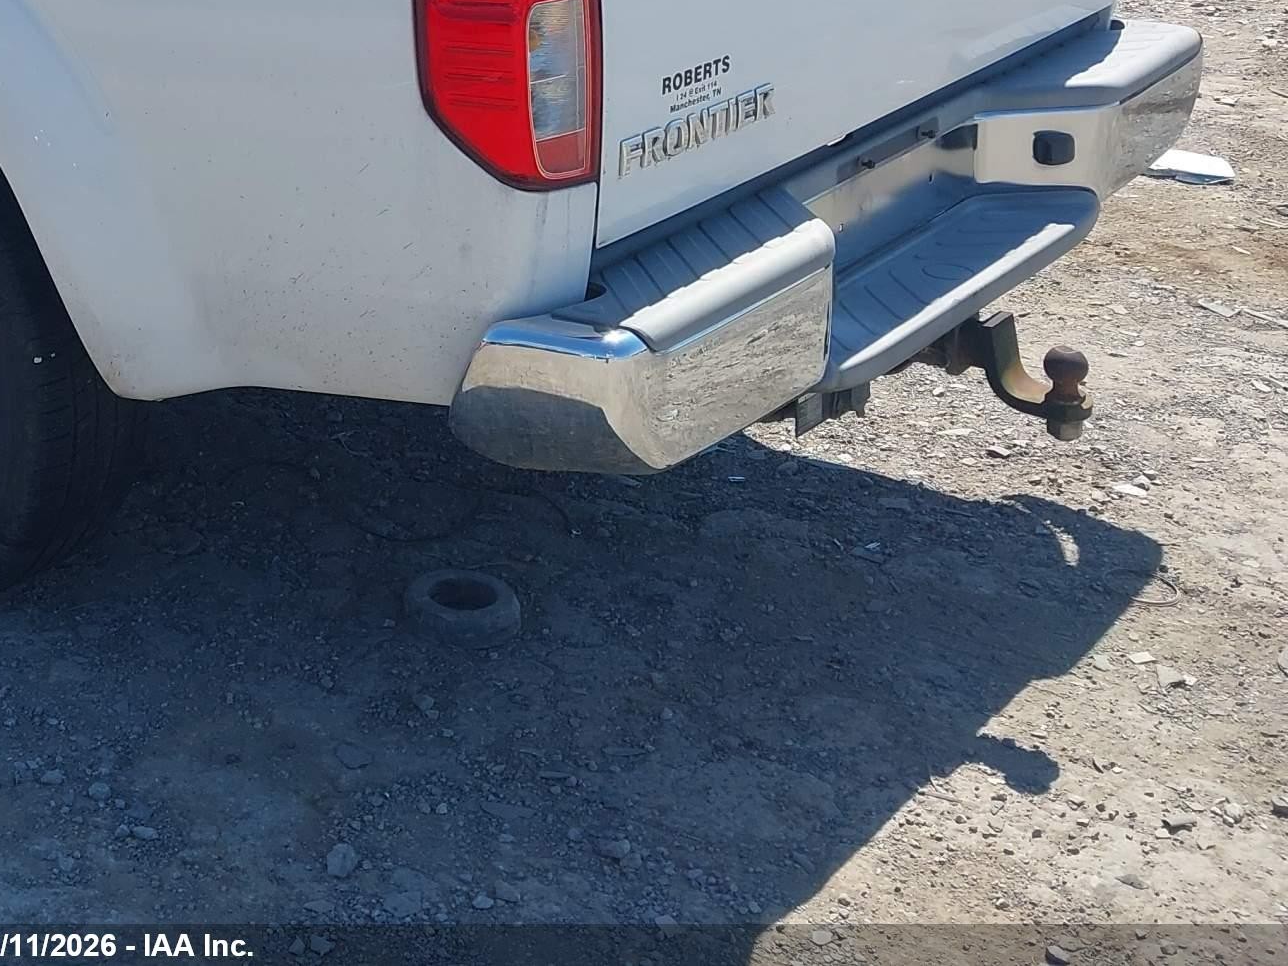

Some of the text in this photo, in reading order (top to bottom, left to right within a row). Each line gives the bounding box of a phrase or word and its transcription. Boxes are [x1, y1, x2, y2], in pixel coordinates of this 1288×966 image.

[661, 55, 730, 95] ROBERTS
[713, 87, 722, 97] TN
[618, 82, 776, 178] FRONTIER
